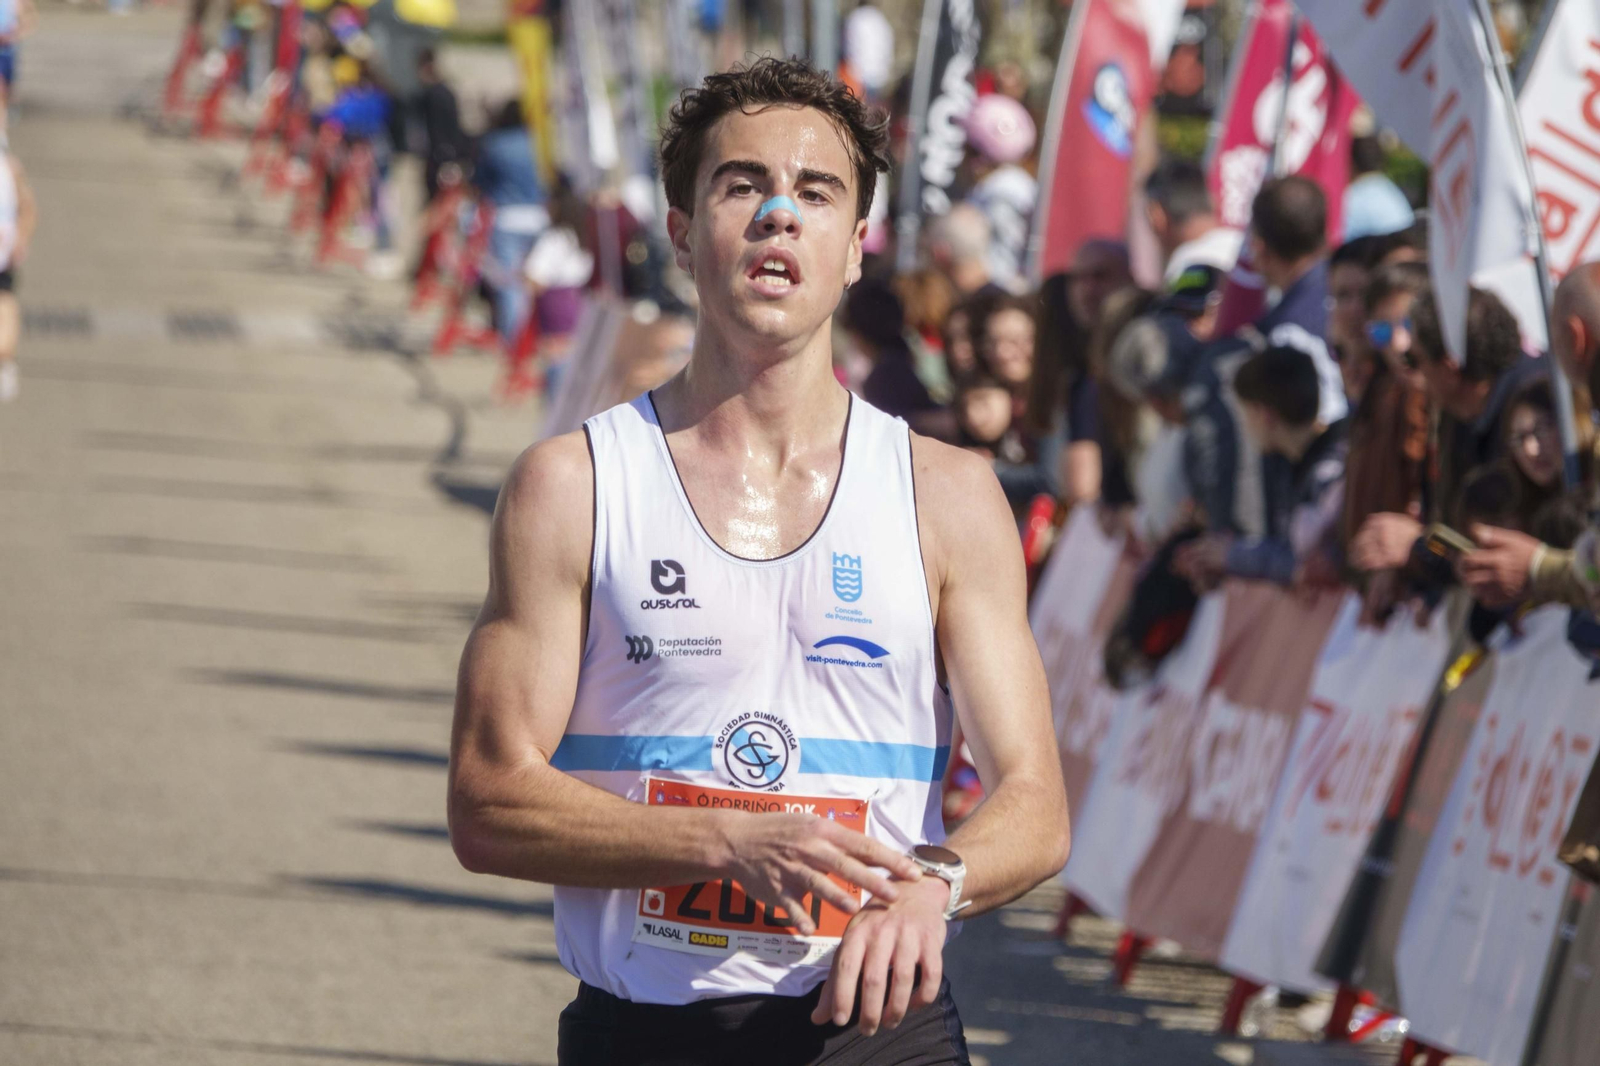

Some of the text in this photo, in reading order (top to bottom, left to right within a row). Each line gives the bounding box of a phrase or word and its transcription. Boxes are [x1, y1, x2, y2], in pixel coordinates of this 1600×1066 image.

[641, 598, 701, 610] austral
[834, 606, 863, 616] Concello
[835, 613, 873, 624] Pontevedra
[659, 636, 722, 648] Deputación
[658, 647, 722, 657] Pontevedra
[806, 654, 883, 669] visit-pontevedra.com
[715, 711, 798, 751] SOCIEDAD GIMNÁSTICA
[711, 795, 781, 813] PORRIÑO
[652, 924, 684, 941] LASAL
[690, 932, 728, 947] GADIS
